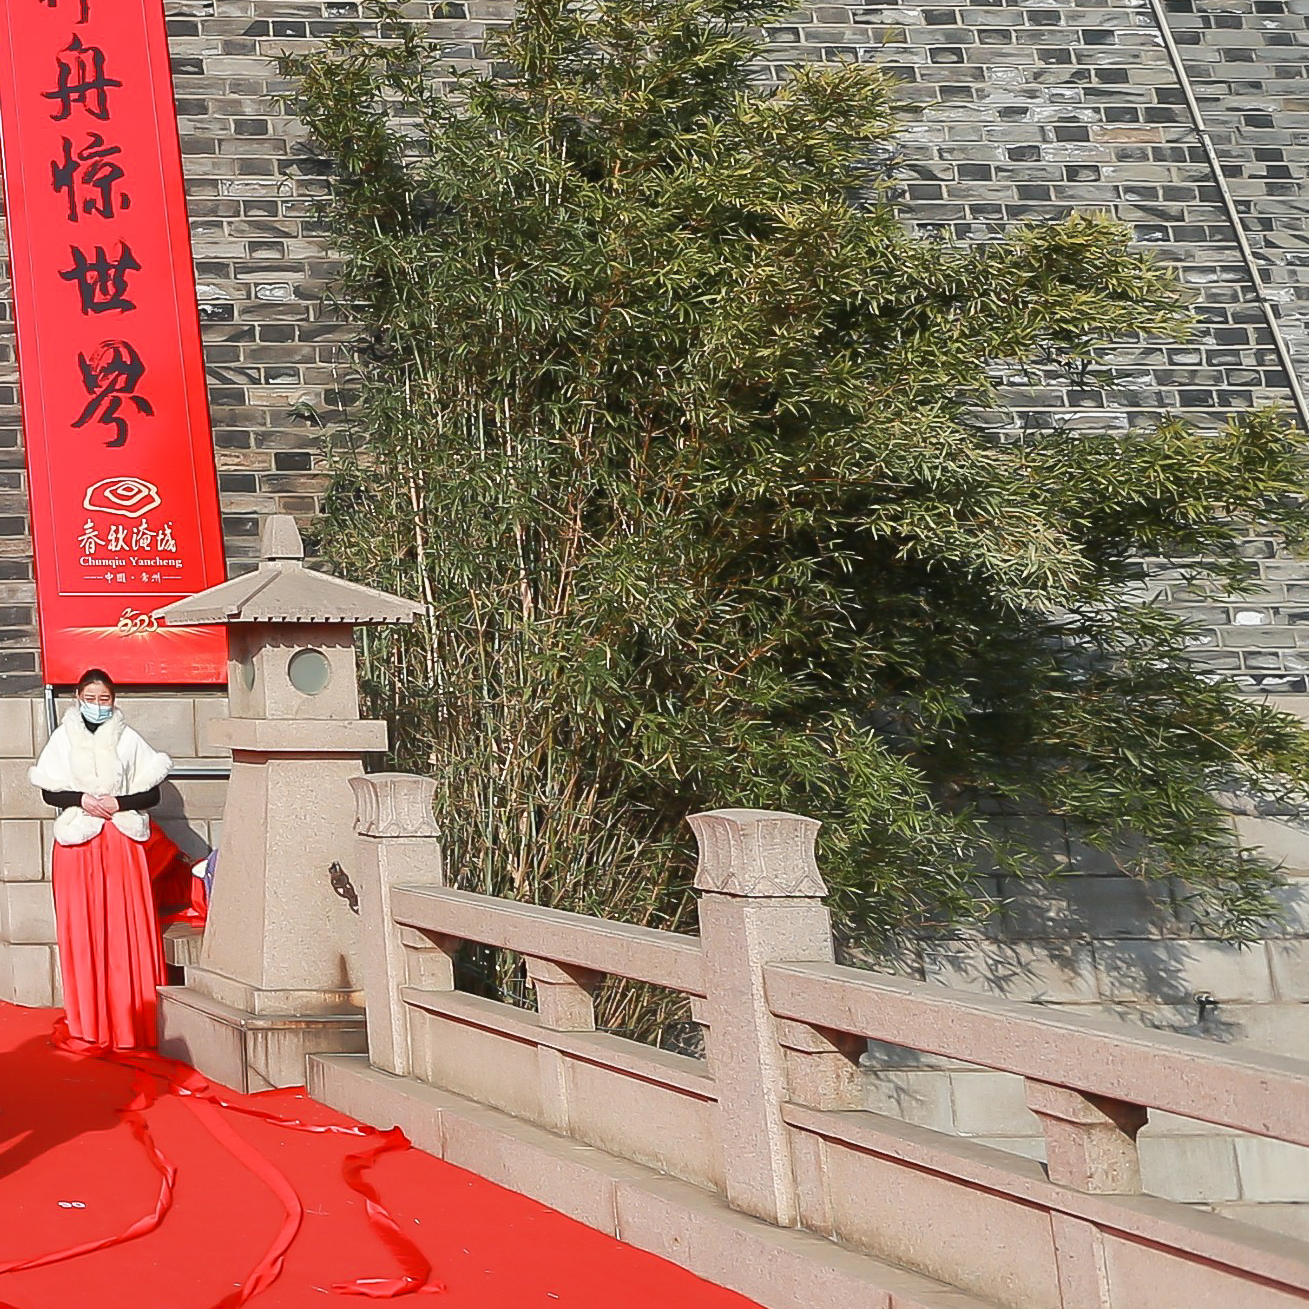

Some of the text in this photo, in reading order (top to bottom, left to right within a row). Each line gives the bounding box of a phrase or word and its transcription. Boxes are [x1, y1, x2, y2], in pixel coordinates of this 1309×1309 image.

[77, 518, 177, 555] 春秋淹城
[79, 556, 183, 568] Chunqiu Yancheng
